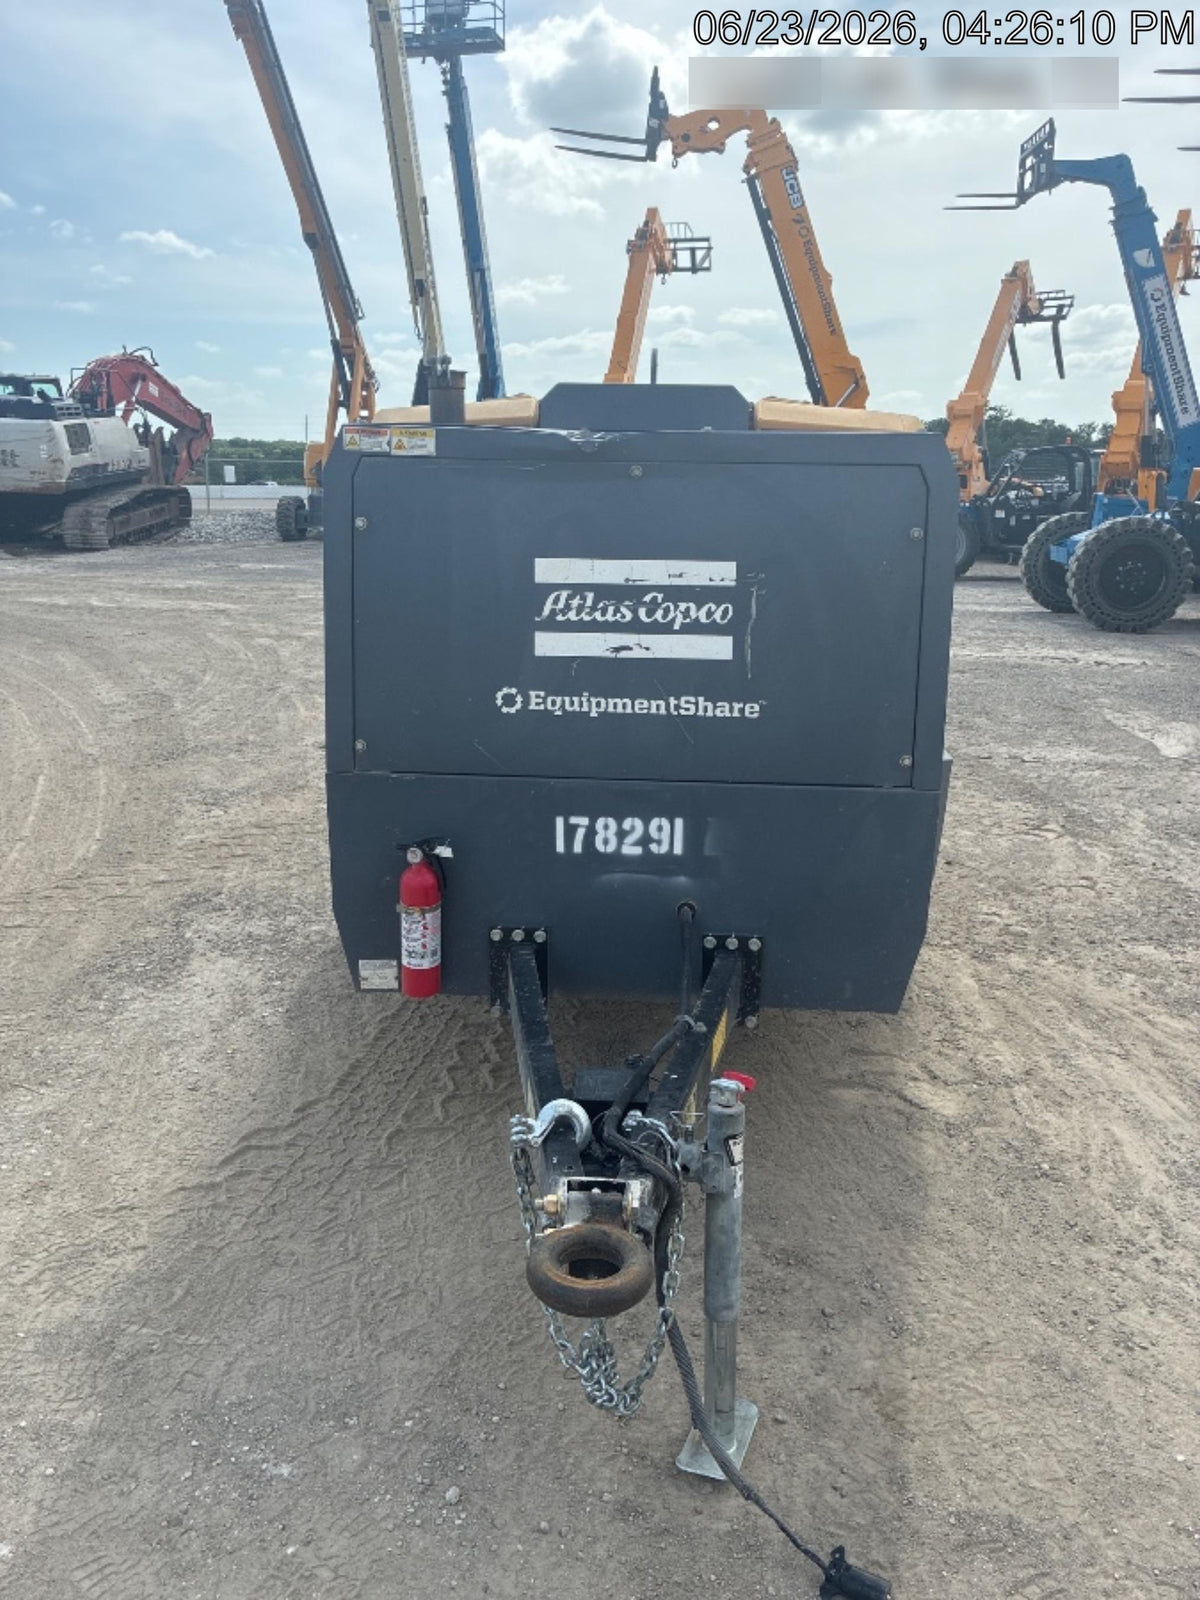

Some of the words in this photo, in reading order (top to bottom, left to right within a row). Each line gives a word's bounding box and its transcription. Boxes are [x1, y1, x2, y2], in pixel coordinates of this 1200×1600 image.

[781, 165, 804, 210] JCB
[1155, 303, 1191, 415] EquipmentShare
[535, 590, 633, 622] Atlas
[638, 592, 733, 630] Copco
[528, 690, 761, 719] EquipmentShare
[555, 815, 684, 855] 178291
